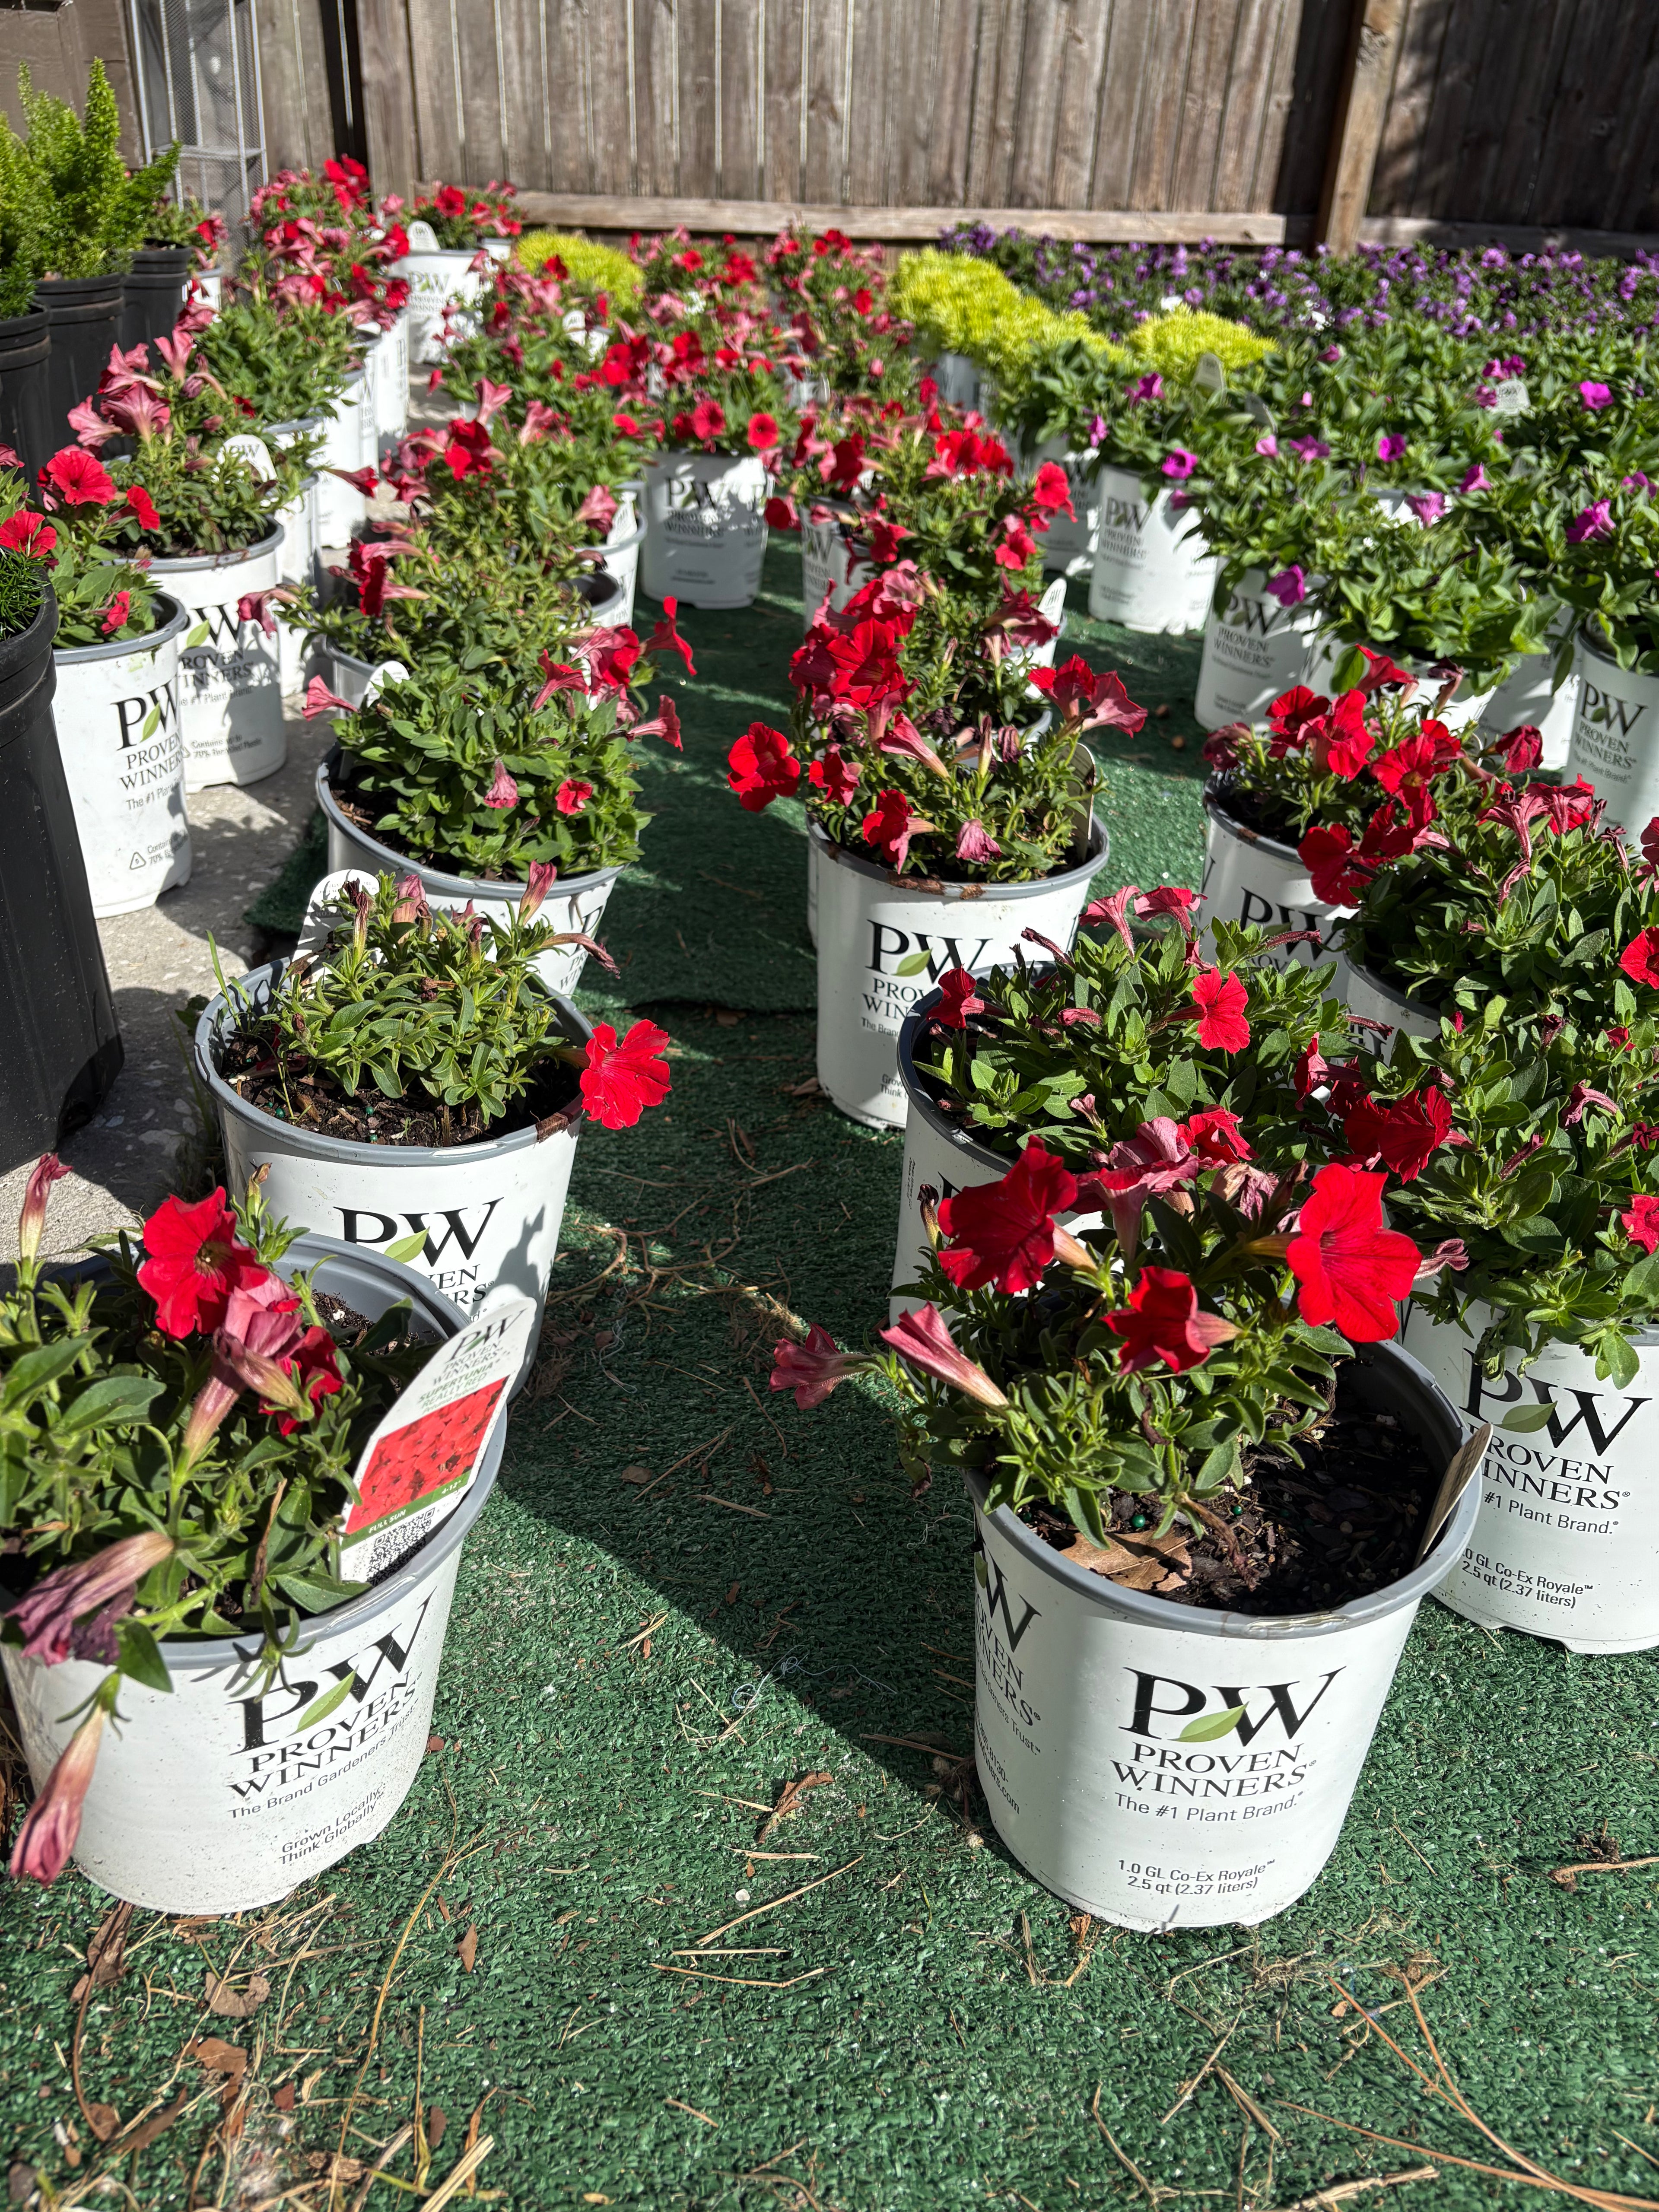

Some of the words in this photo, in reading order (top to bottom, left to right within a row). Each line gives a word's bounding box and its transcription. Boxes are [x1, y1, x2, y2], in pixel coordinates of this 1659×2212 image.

[408, 271, 450, 294] PW
[665, 476, 727, 509] PW
[1105, 496, 1153, 534] PW
[1213, 636, 1274, 669] WINNERS
[1218, 625, 1270, 653] PROVEN
[182, 647, 243, 670] ROVEN
[183, 660, 254, 689] INNERS
[110, 682, 178, 751] PW
[1580, 679, 1649, 737] PW
[1580, 719, 1630, 754] PROVEN
[118, 746, 184, 791] WINNER
[126, 798, 144, 811] The
[864, 919, 993, 984] PW
[861, 1017, 877, 1031] The
[880, 1084, 902, 1098] Think
[333, 1201, 505, 1267] PW
[445, 1307, 528, 1364] PW
[443, 1340, 502, 1373] PROVEN
[420, 1380, 463, 1409] REALLY
[463, 1372, 487, 1387] RED
[1459, 1348, 1653, 1456] PW
[1468, 1422, 1615, 1484] ROVEN
[1482, 1456, 1630, 1510] INNERS®
[369, 1517, 388, 1534] FULL
[389, 1509, 407, 1523] SUN
[1484, 1491, 1501, 1508] #1
[1509, 1499, 1553, 1525] Plant
[1462, 1560, 1481, 1579] 2.5
[1483, 1574, 1498, 1586] qt
[1500, 1577, 1533, 1597] (2.37
[1536, 1589, 1576, 1609] liters)
[1463, 1548, 1473, 1560] .0
[1476, 1554, 1492, 1570] GL
[1495, 1562, 1534, 1585] Co-Ex
[976, 1592, 1024, 1691] OVEN
[226, 1586, 437, 1756] PW
[979, 1658, 1009, 1724] Gardeners
[1118, 1665, 1347, 1747] PW
[226, 1677, 417, 1798] WINNERS
[248, 1666, 412, 1773] PROVEN
[1130, 1742, 1305, 1773] PROVEN
[228, 1806, 261, 1819] The
[267, 1782, 313, 1808] Brand
[318, 1735, 386, 1787] Gardeners
[1114, 1792, 1150, 1814] The
[1155, 1805, 1177, 1820] #1
[1186, 1807, 1238, 1822] Plant
[278, 1841, 320, 1865] Think
[282, 1824, 331, 1853] Grown
[1118, 1859, 1141, 1875] 1.0
[1145, 1866, 1167, 1879] GL
[1170, 1870, 1214, 1882] Co-Ex
[1127, 1876, 1151, 1891] 2.5
[1155, 1880, 1173, 1895] qt
[1175, 1882, 1214, 1896] (2.37
[1217, 1876, 1259, 1894] liters)
